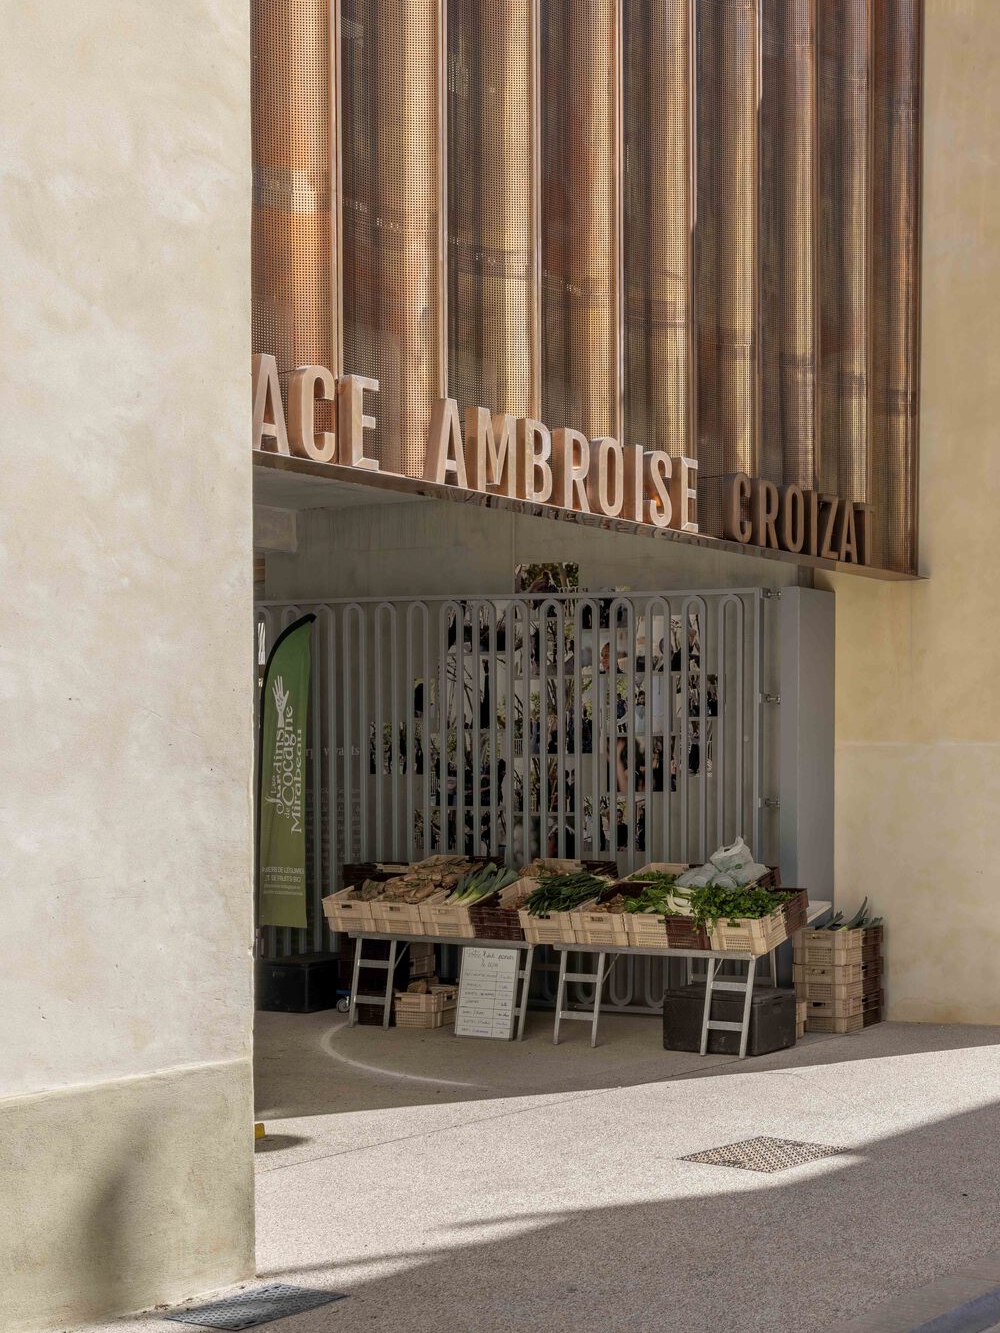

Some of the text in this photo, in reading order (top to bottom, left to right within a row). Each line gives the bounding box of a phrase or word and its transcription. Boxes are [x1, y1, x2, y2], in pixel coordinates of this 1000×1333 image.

[420, 398, 699, 533] AMBROISE
[723, 472, 876, 566] CROIZAT
[264, 729, 285, 815] Jardins
[281, 705, 297, 807] Cocagne
[290, 729, 303, 834] Mirabeau
